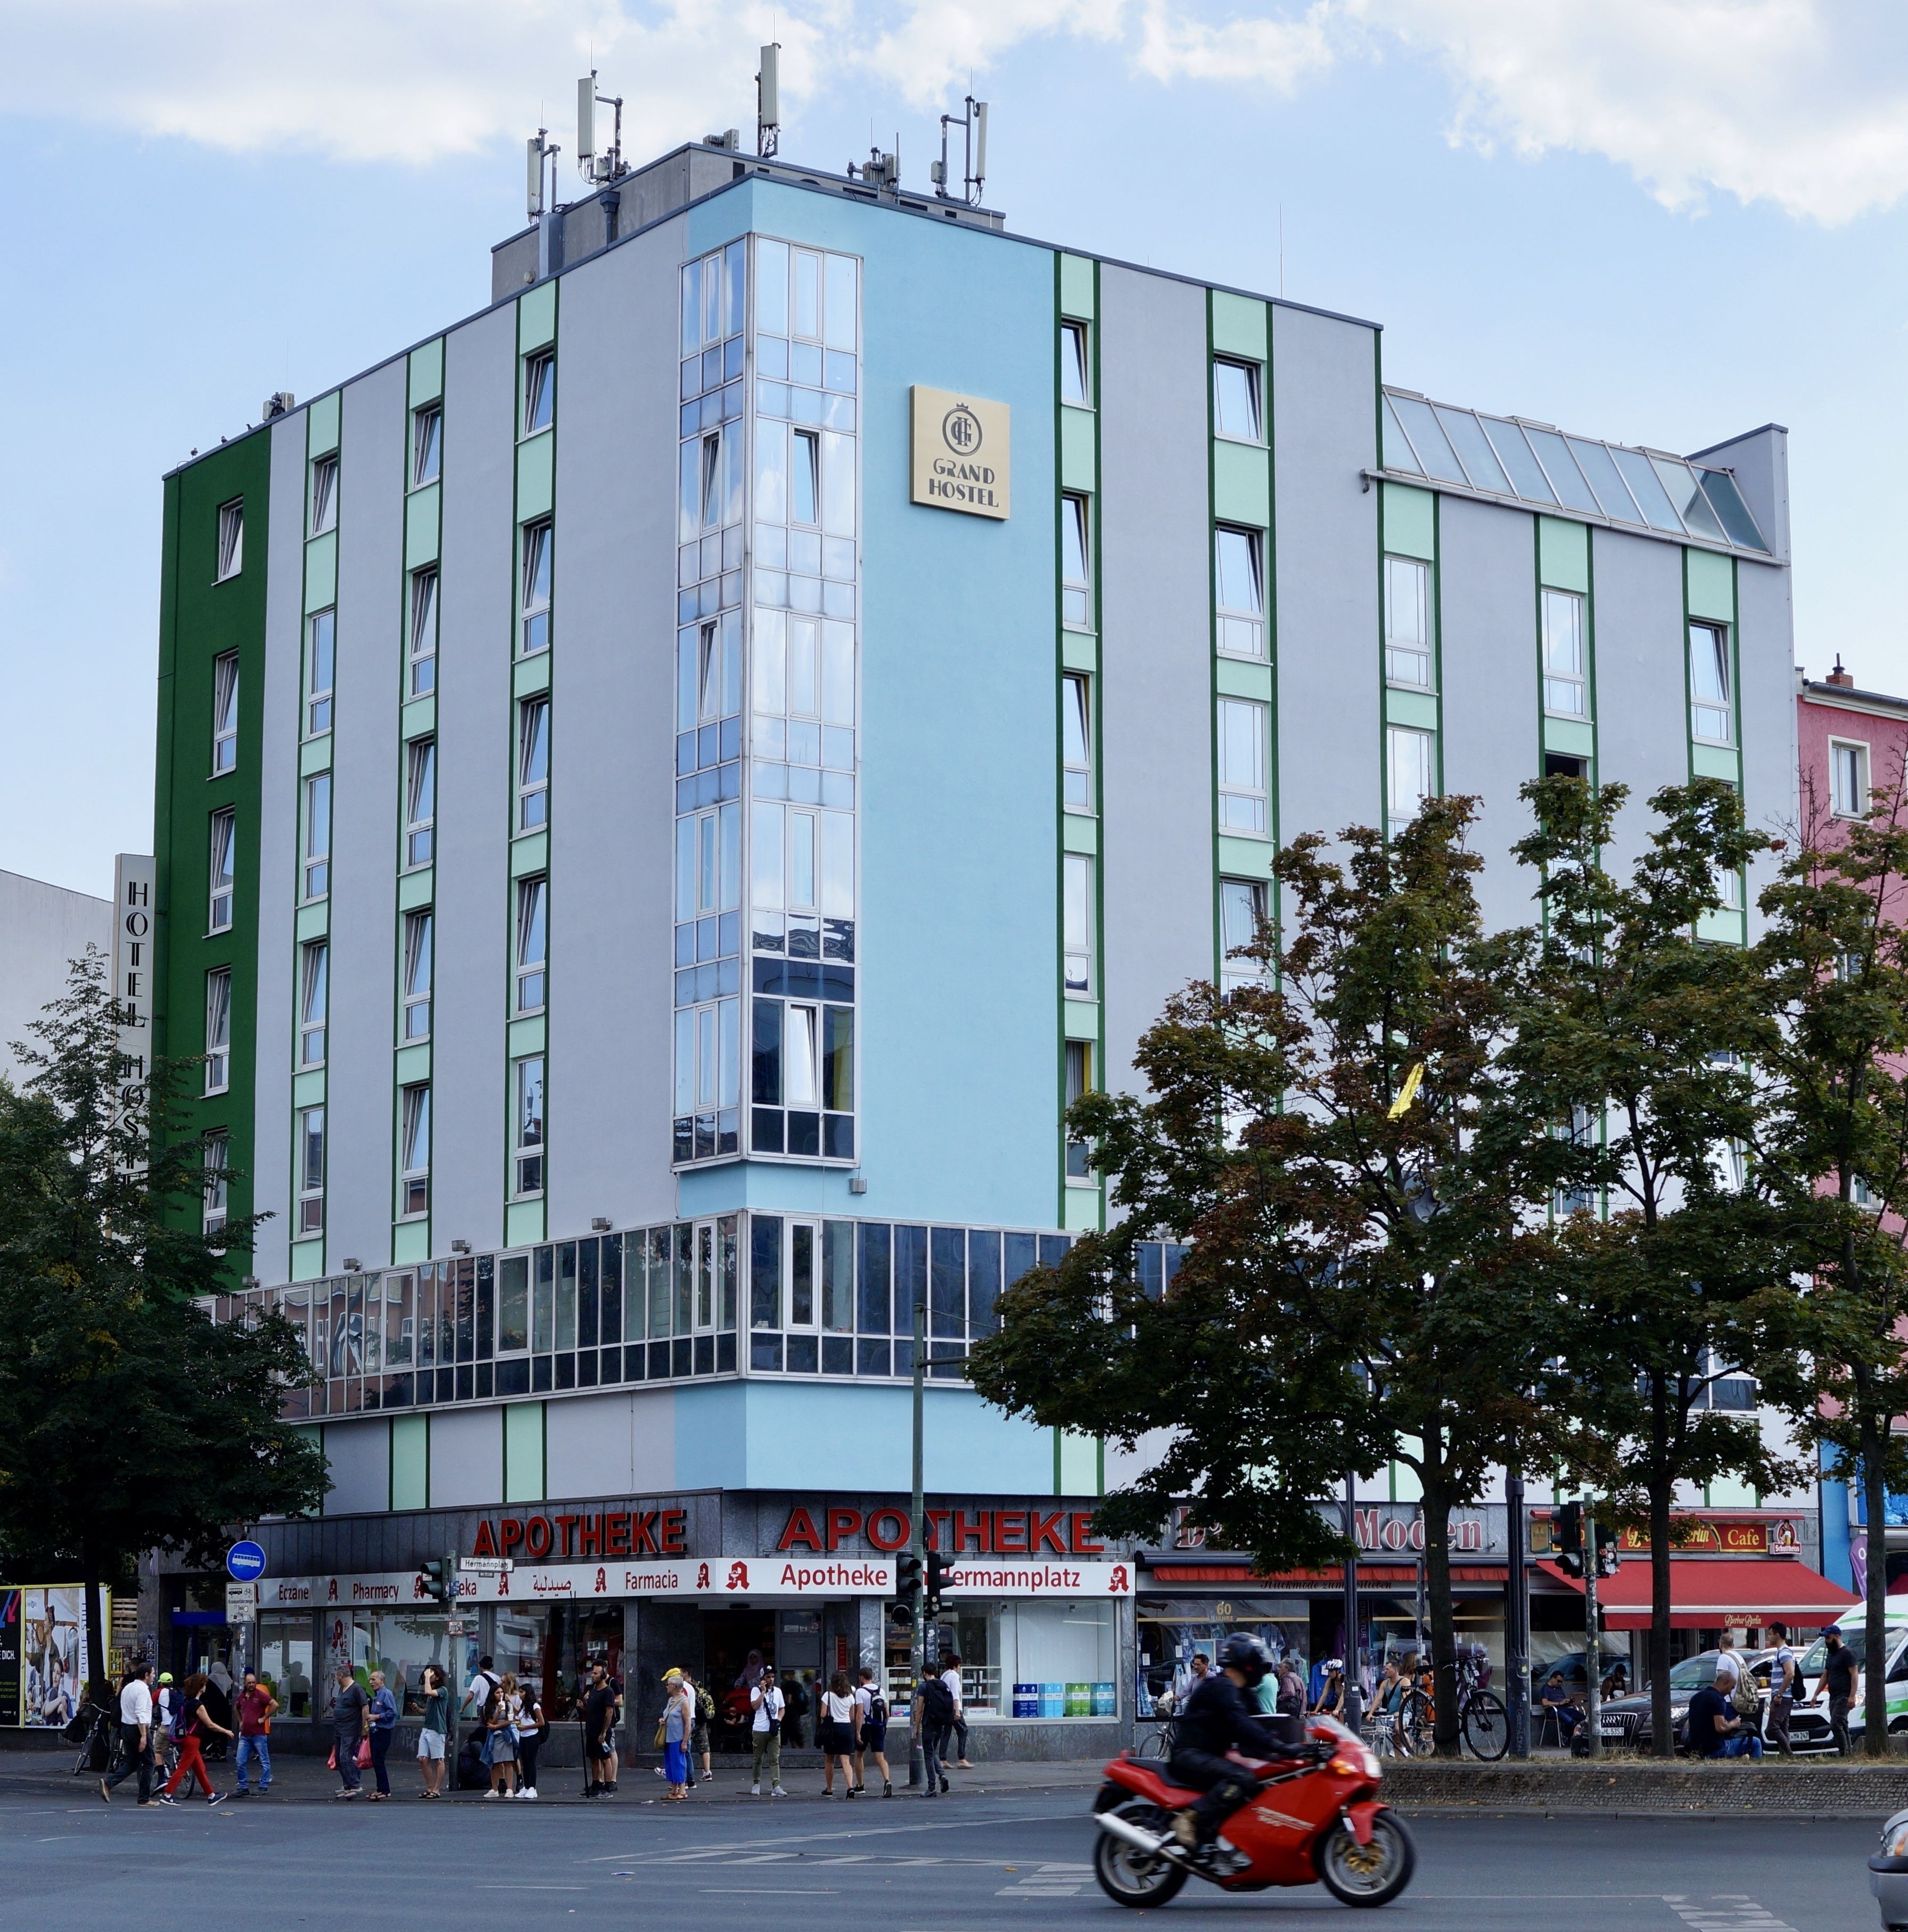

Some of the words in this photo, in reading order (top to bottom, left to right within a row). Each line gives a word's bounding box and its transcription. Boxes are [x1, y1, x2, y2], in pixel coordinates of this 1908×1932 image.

[933, 458, 995, 484] GRAND
[929, 478, 999, 507] HOSTEL
[126, 882, 149, 1027] HOTEL
[473, 1509, 684, 1557] APOTHEKE
[778, 1507, 1105, 1552] APOTHEKE
[1728, 1528, 1759, 1545] Cafe
[465, 1559, 508, 1570] Hermannplatz
[458, 1577, 477, 1596] eka
[532, 1574, 572, 1597] صيدلية
[625, 1569, 679, 1590] Farmacia
[780, 1563, 888, 1590] Apotheke
[942, 1565, 1081, 1592] ermannplatz
[278, 1584, 309, 1601] Eczane
[352, 1583, 399, 1602] Pharmacy
[1216, 1602, 1232, 1616] 60
[1745, 1614, 1762, 1627] Berlin
[2, 1650, 16, 1660] DICH.
